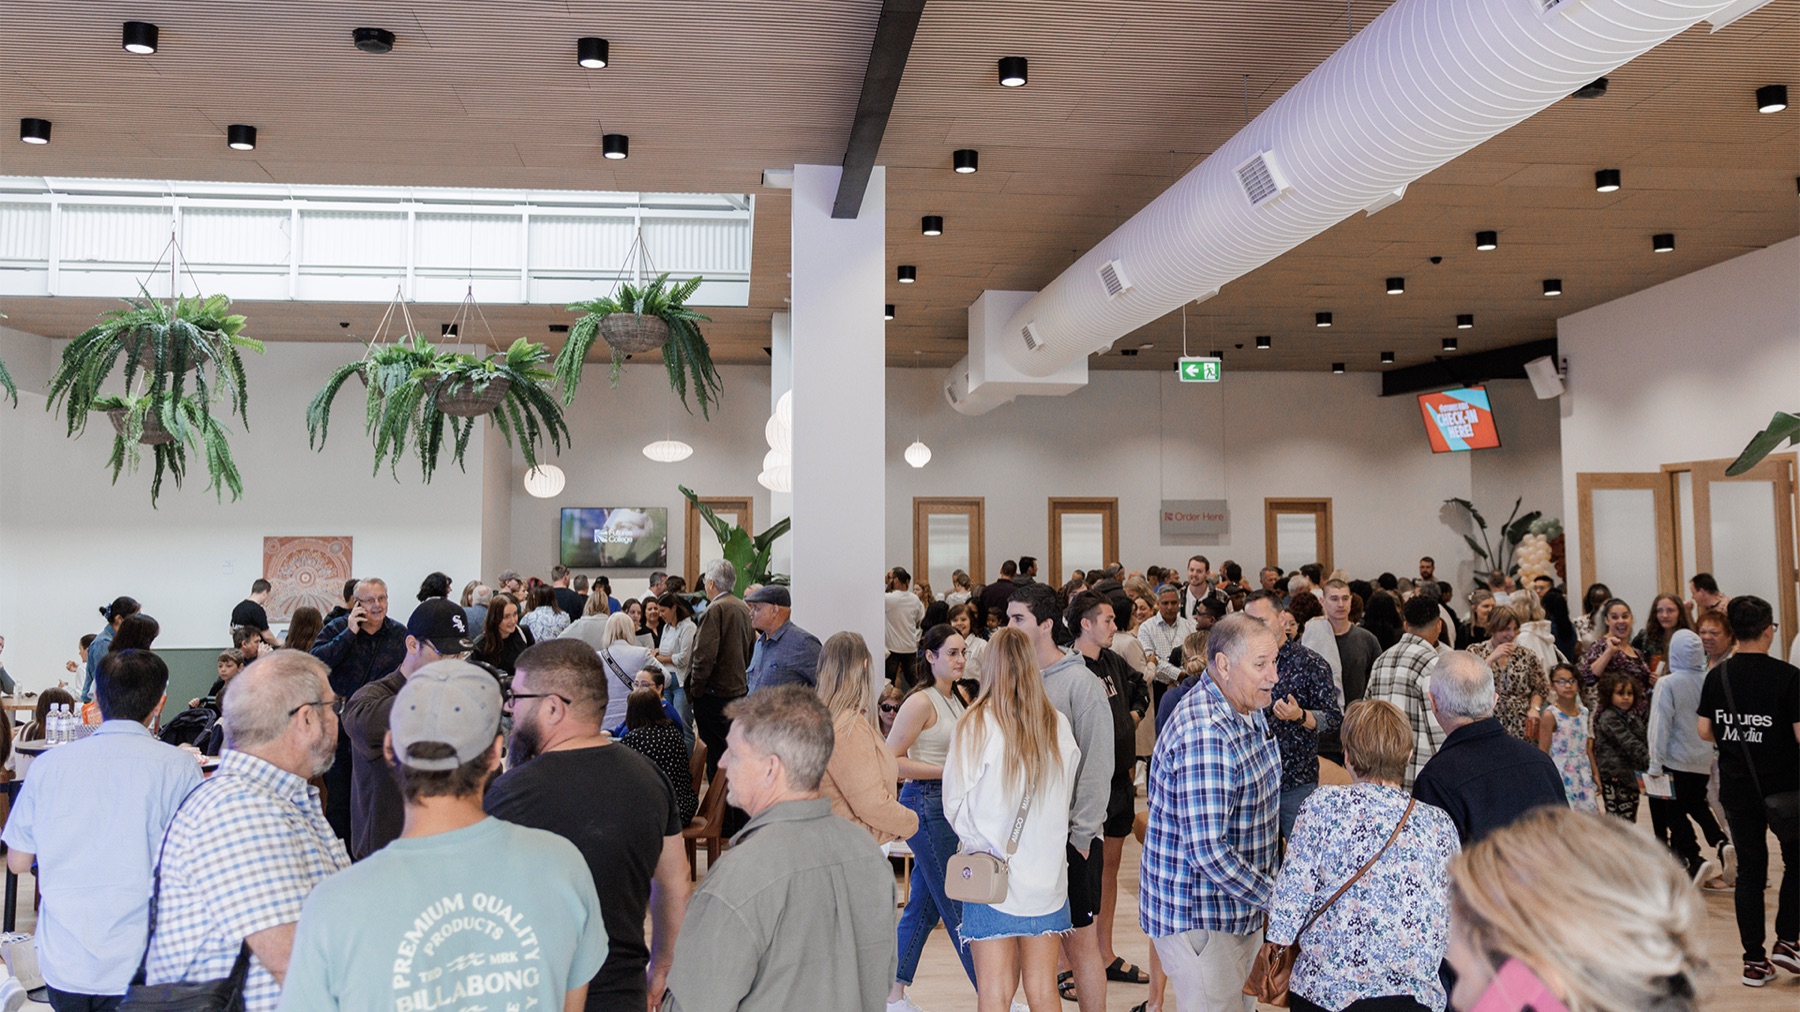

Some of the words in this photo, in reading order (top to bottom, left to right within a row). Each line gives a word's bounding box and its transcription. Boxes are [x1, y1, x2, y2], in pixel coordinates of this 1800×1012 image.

[1437, 409, 1479, 427] CHECK-IN
[1447, 424, 1475, 439] HERE!
[1175, 512, 1200, 521] Order
[1202, 512, 1224, 521] Here
[608, 535, 633, 544] College
[1715, 709, 1773, 727] Fuures
[1722, 725, 1763, 743] Mdia
[392, 892, 465, 990] PREMIUM
[471, 892, 541, 961] QUALITY
[423, 916, 504, 957] PRODUCTS
[489, 951, 519, 965] MRK
[395, 966, 540, 1012] BILLABONG
